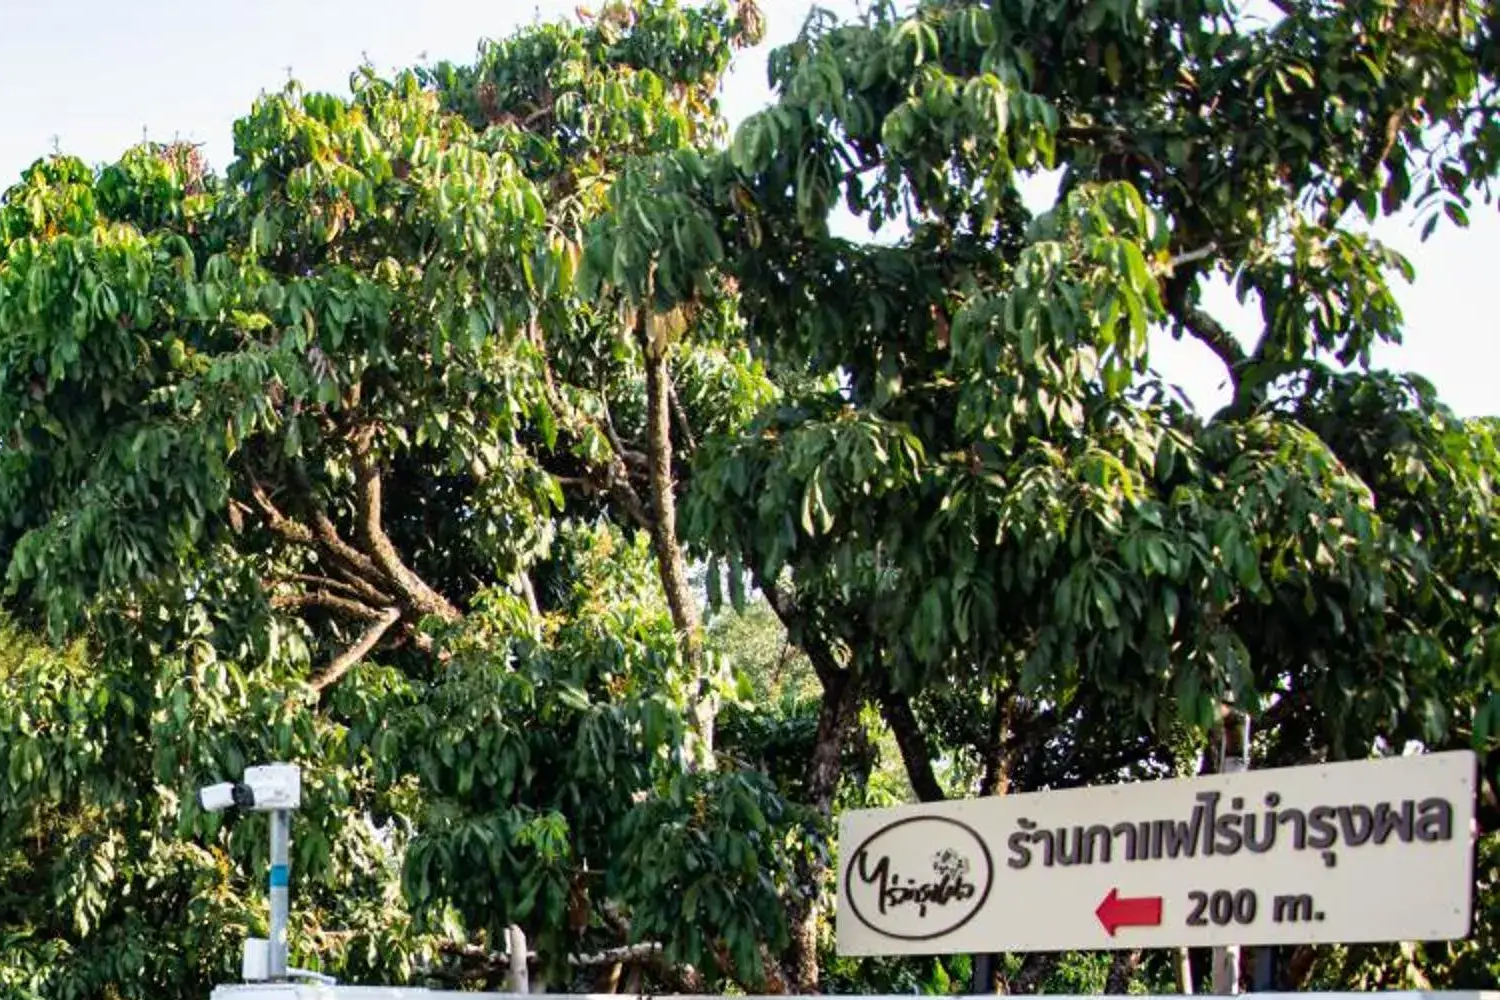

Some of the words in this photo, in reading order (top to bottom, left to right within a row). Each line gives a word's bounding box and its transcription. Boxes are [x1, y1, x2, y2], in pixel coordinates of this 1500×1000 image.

[1007, 792, 1453, 868] ร้านกาแฟไร่บำรุงผล
[1186, 889, 1257, 926] 200
[1272, 893, 1325, 922] m.
